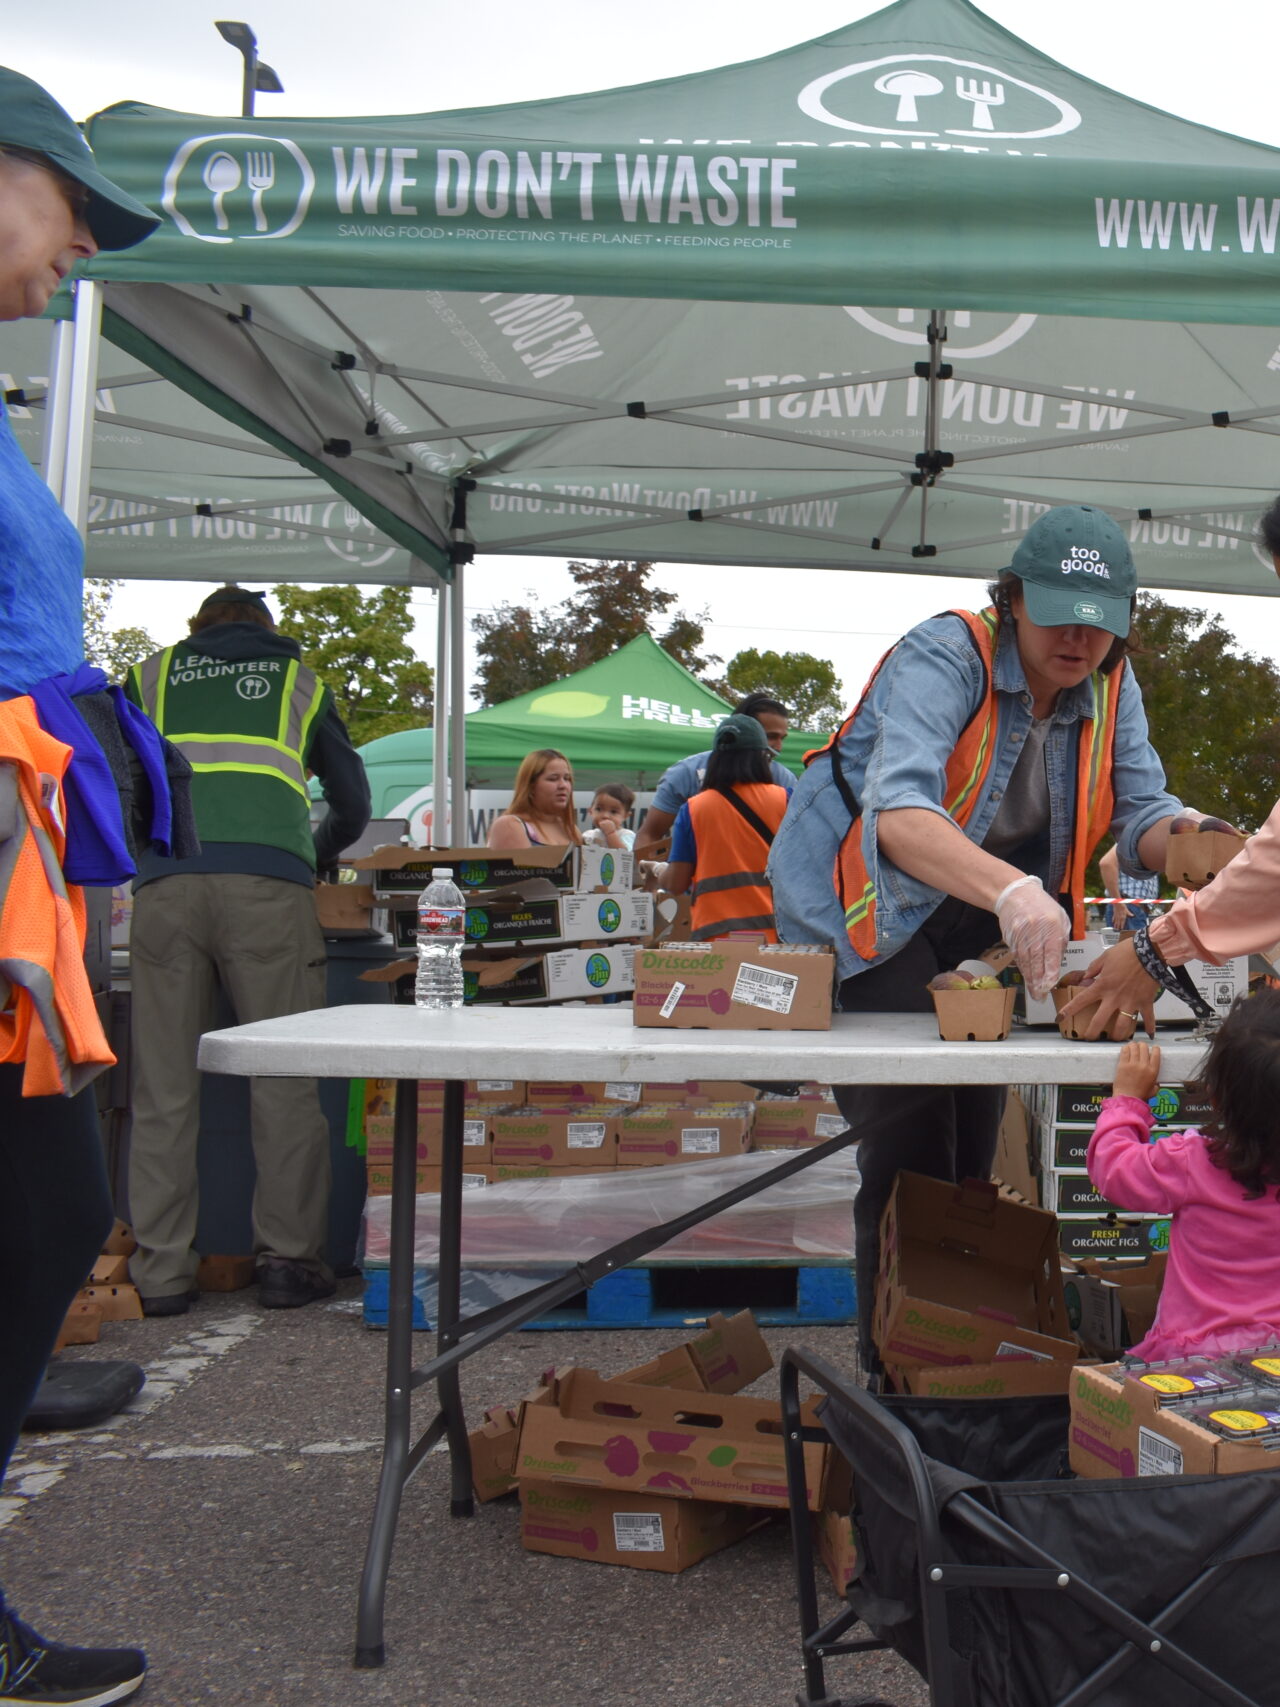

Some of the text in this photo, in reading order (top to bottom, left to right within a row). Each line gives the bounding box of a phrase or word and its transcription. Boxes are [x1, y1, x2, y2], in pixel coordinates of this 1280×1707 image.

[332, 147, 798, 229] WE DON'T WASTE
[338, 224, 793, 249] SAVING FOOD PROTECTING THE PLANET FEEDING PEOPLE
[1070, 545, 1100, 561] too
[1061, 559, 1105, 577] good
[169, 661, 281, 687] VOLUNTEER
[420, 916, 449, 924] ARROWHEAD
[642, 951, 726, 971] Driscoll's
[1072, 1238, 1140, 1248] ORGANIC FIGS
[1091, 1229, 1120, 1239] FRESH
